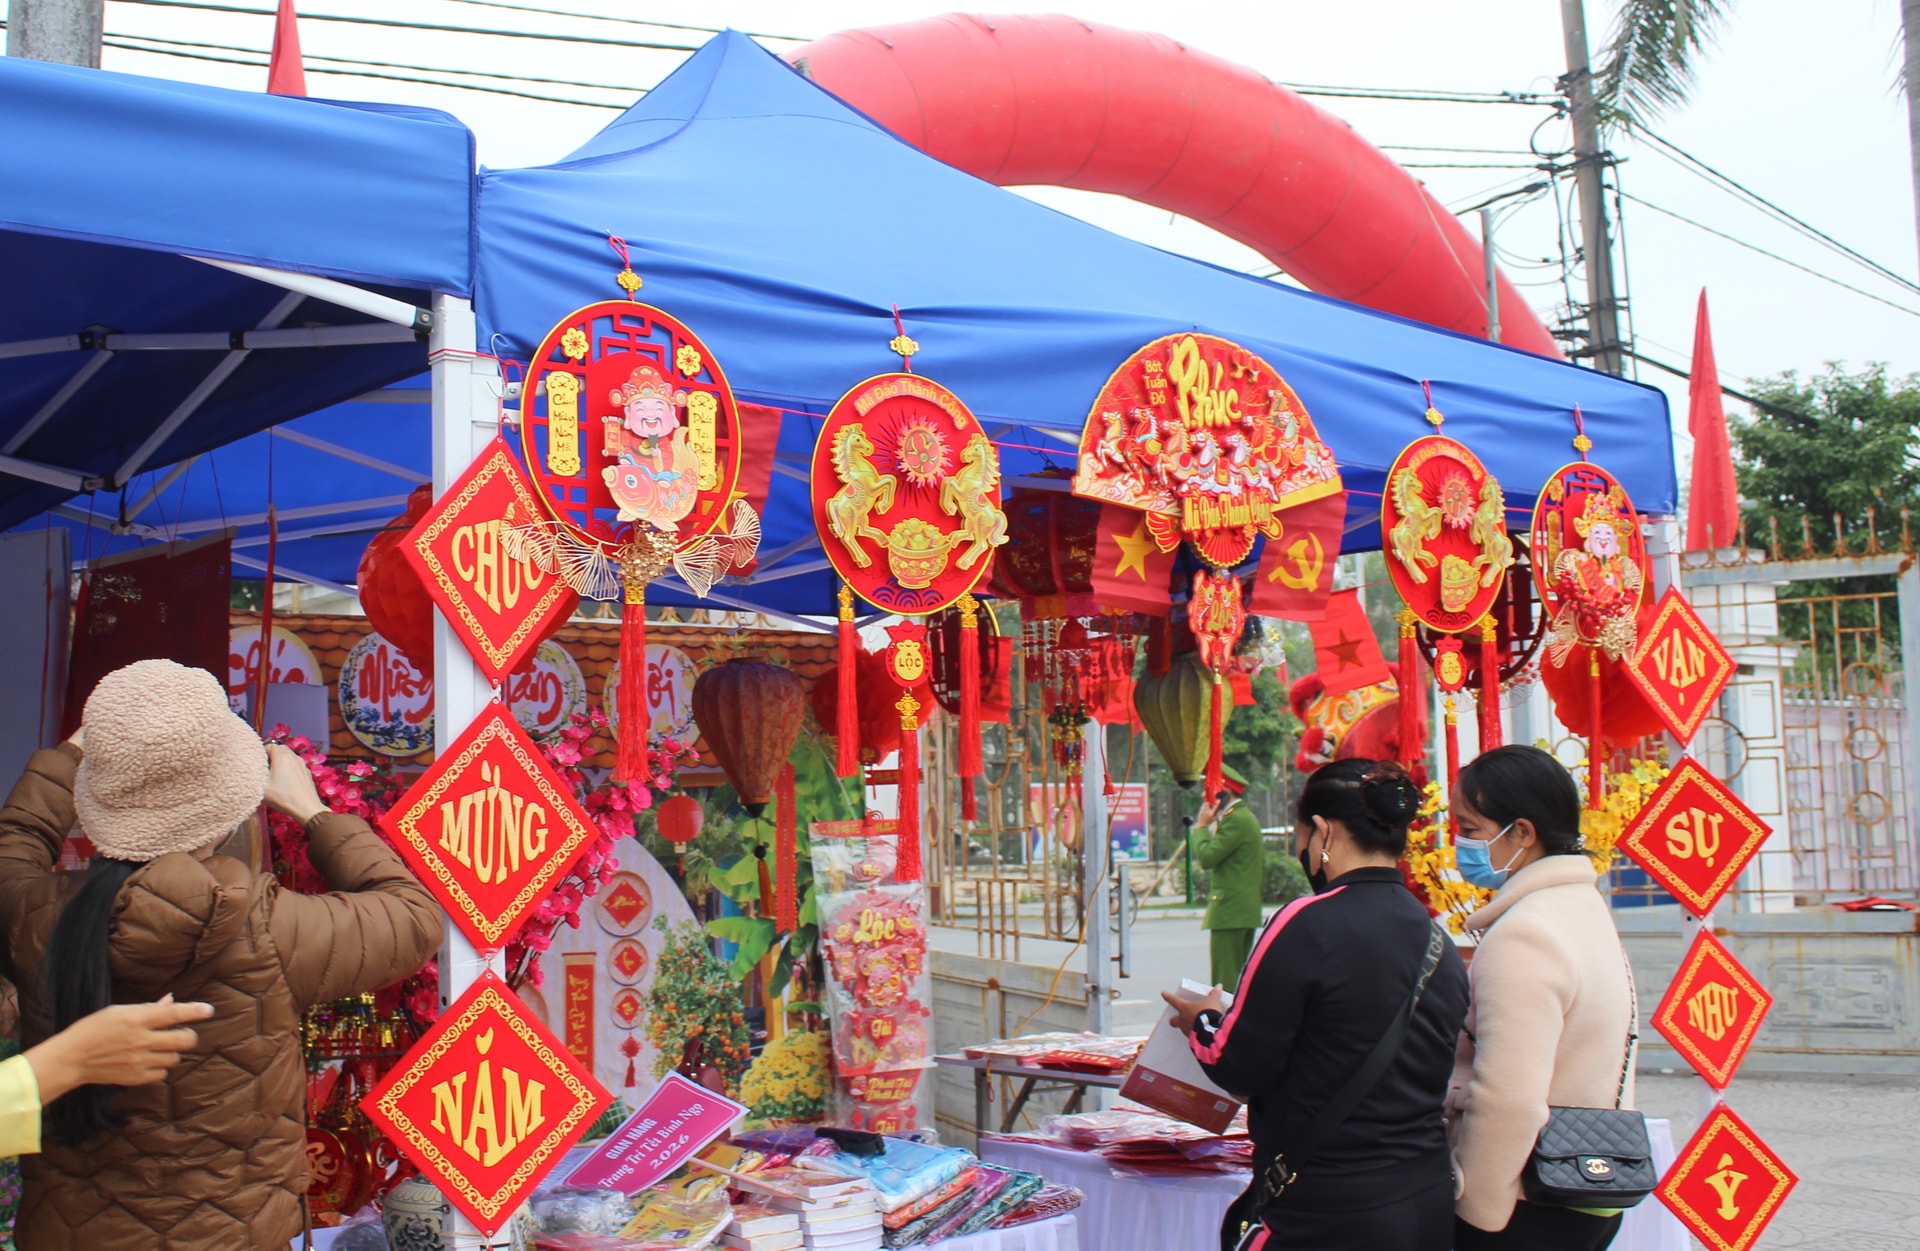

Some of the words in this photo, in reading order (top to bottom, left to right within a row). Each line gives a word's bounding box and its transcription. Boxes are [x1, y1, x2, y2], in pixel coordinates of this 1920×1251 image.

[1169, 336, 1243, 428] Phúc
[898, 652, 921, 671] LỘC
[1652, 627, 1706, 706] VẠN
[439, 759, 549, 885] MỪNG
[1665, 807, 1724, 868] SỰ
[853, 908, 897, 948] Lộc
[1686, 981, 1739, 1042] NHƯ
[430, 1026, 546, 1168] NĂM
[598, 1164, 635, 1188] Trang
[625, 1148, 646, 1166] Trí
[640, 1137, 662, 1153] Tết
[656, 1118, 684, 1140] Bính
[682, 1103, 705, 1123] Ngọ
[605, 1139, 633, 1160] GIAN
[630, 1117, 658, 1141] HÀNG
[650, 1134, 690, 1170] 2026
[1704, 1152, 1749, 1221] Ý
